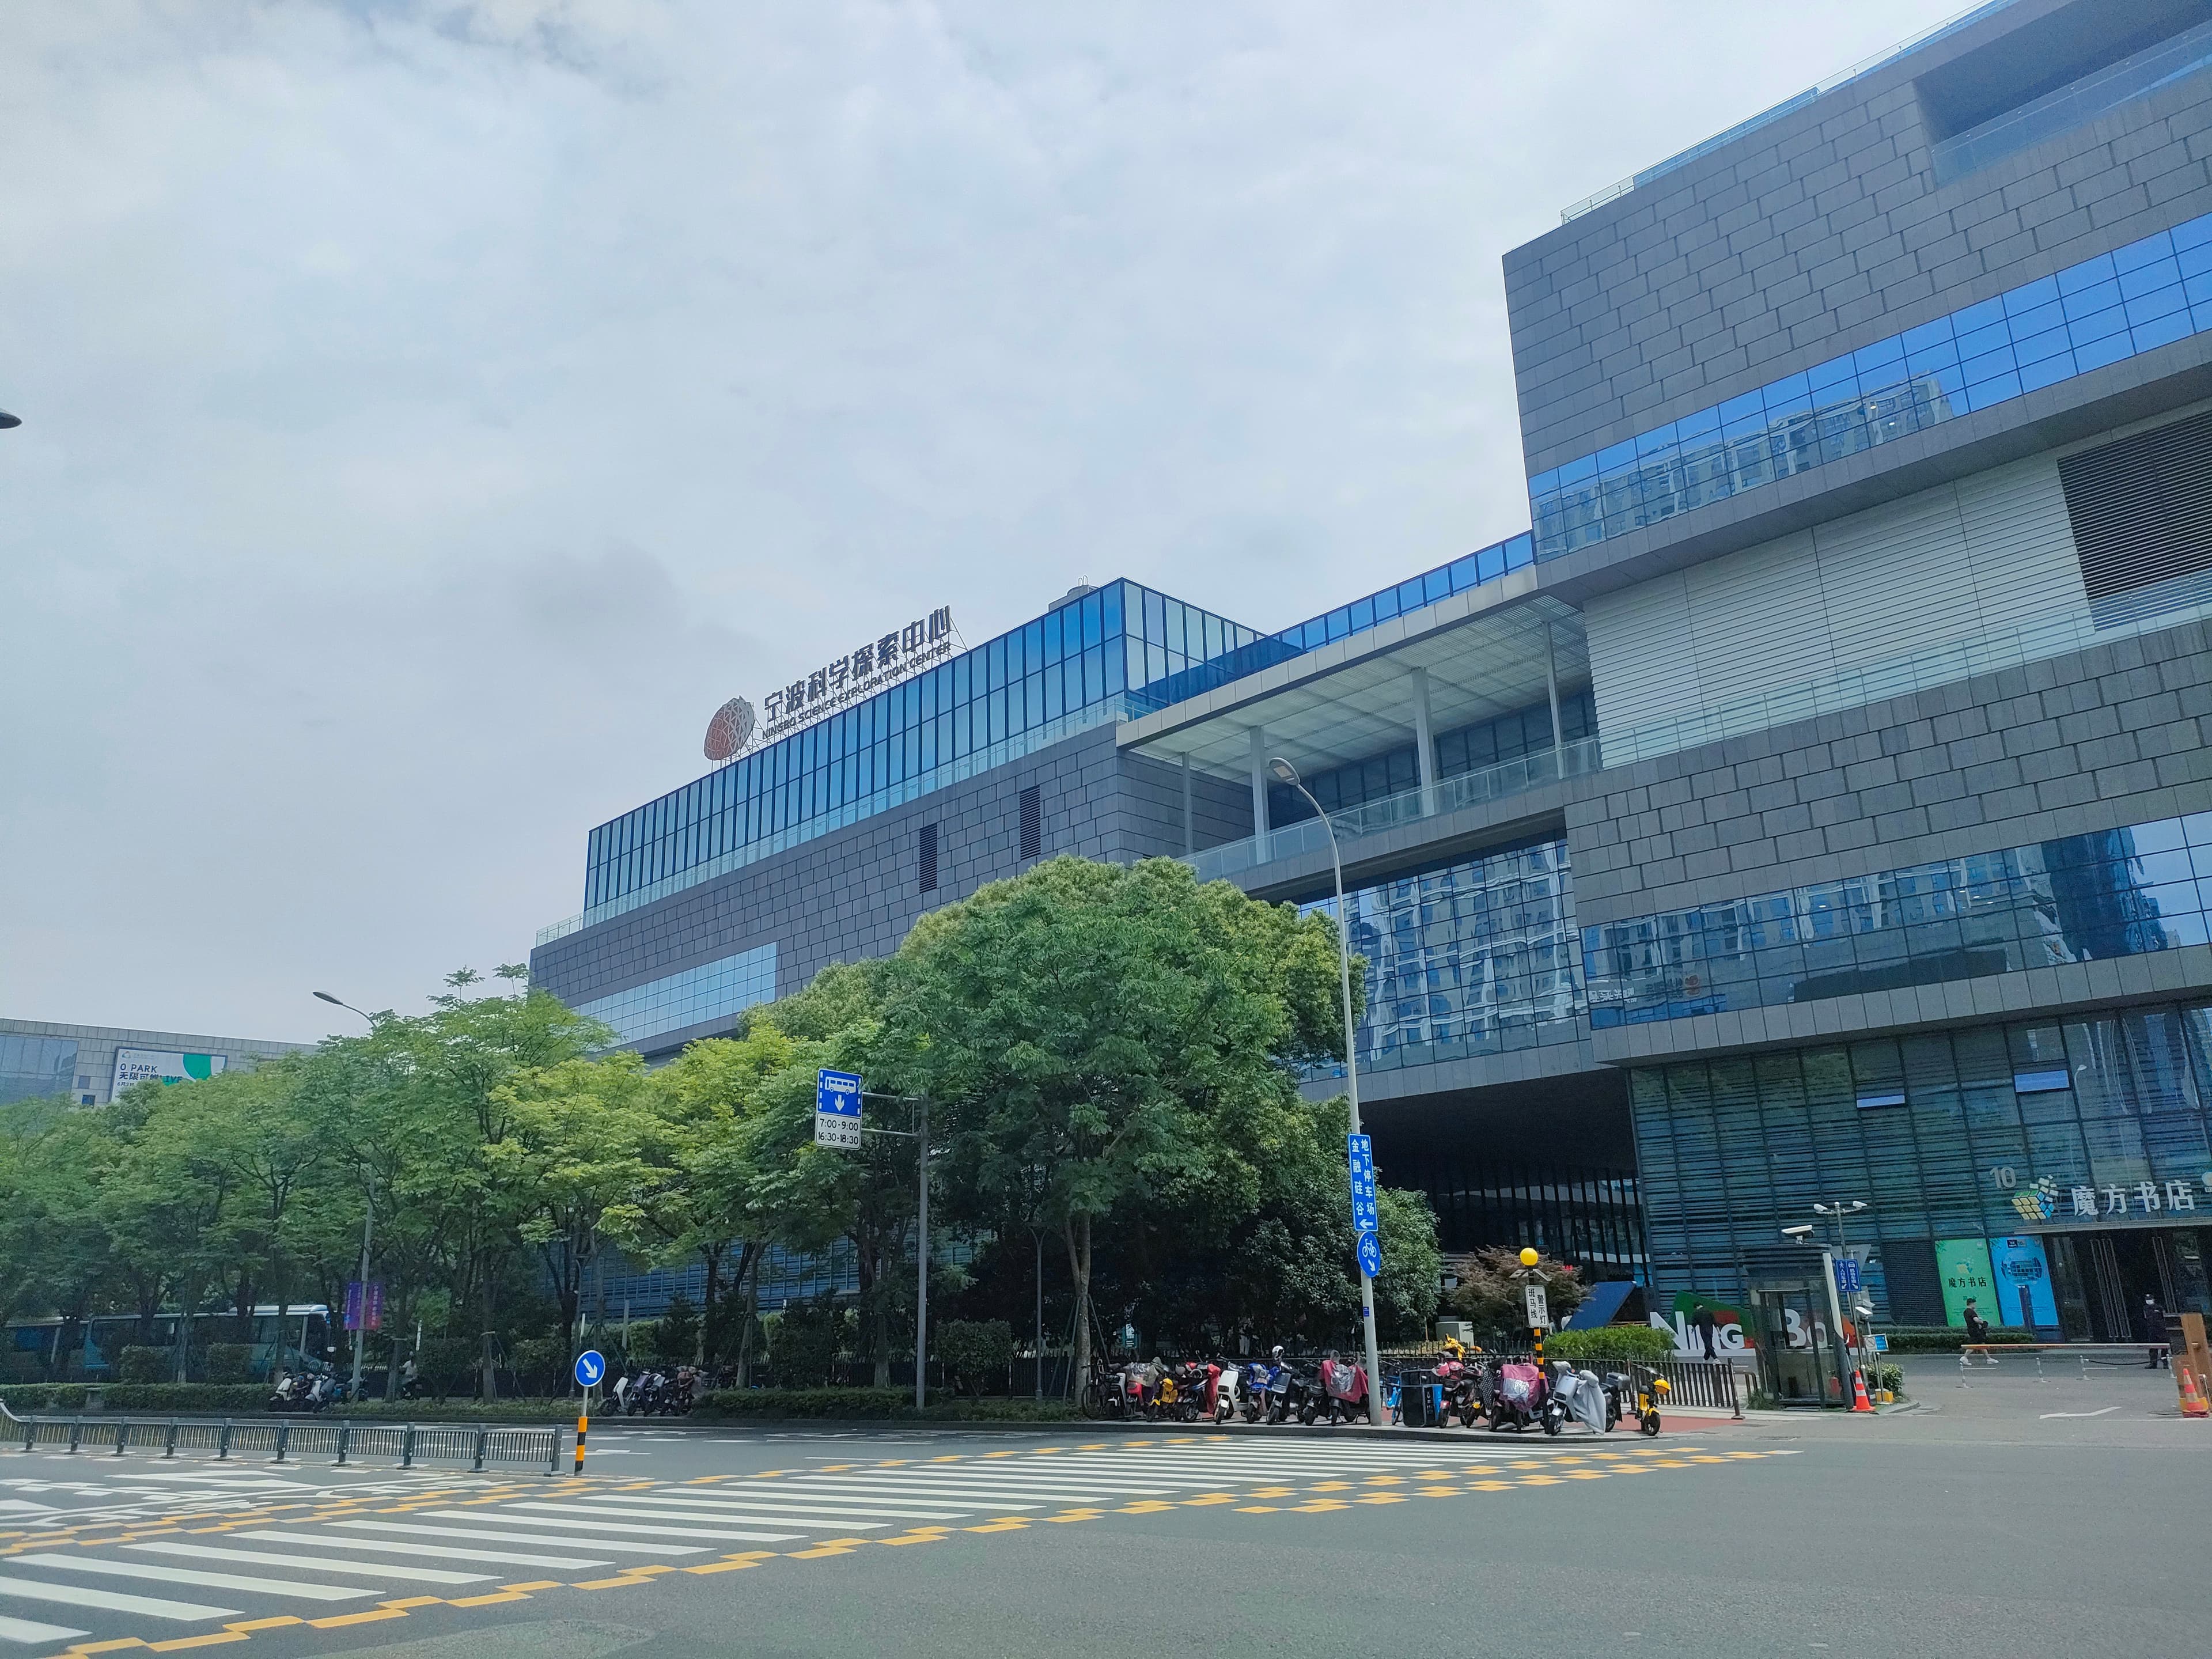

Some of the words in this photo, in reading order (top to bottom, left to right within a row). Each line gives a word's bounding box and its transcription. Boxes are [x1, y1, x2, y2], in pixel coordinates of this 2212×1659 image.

[764, 605, 951, 722] 宁波科学探索中心
[762, 717, 796, 740] NINGBO
[798, 698, 836, 721] SCIENCE
[838, 664, 906, 703] EXPLORATION
[910, 641, 951, 668] CENTER
[131, 1064, 158, 1073] PARK
[818, 1132, 858, 1145] 16:30-18:30
[820, 1119, 858, 1131] 7:00-9:00
[1351, 1139, 1364, 1215] 金融硅谷
[1361, 1138, 1374, 1215] 地下停车场
[1990, 1166, 2016, 1188] 10
[2071, 1179, 2195, 1217] 魔方书店
[1948, 1277, 1987, 1288] 魔方书店
[1528, 1288, 1537, 1319] 斑马线
[1537, 1294, 1546, 1324] 警示灯
